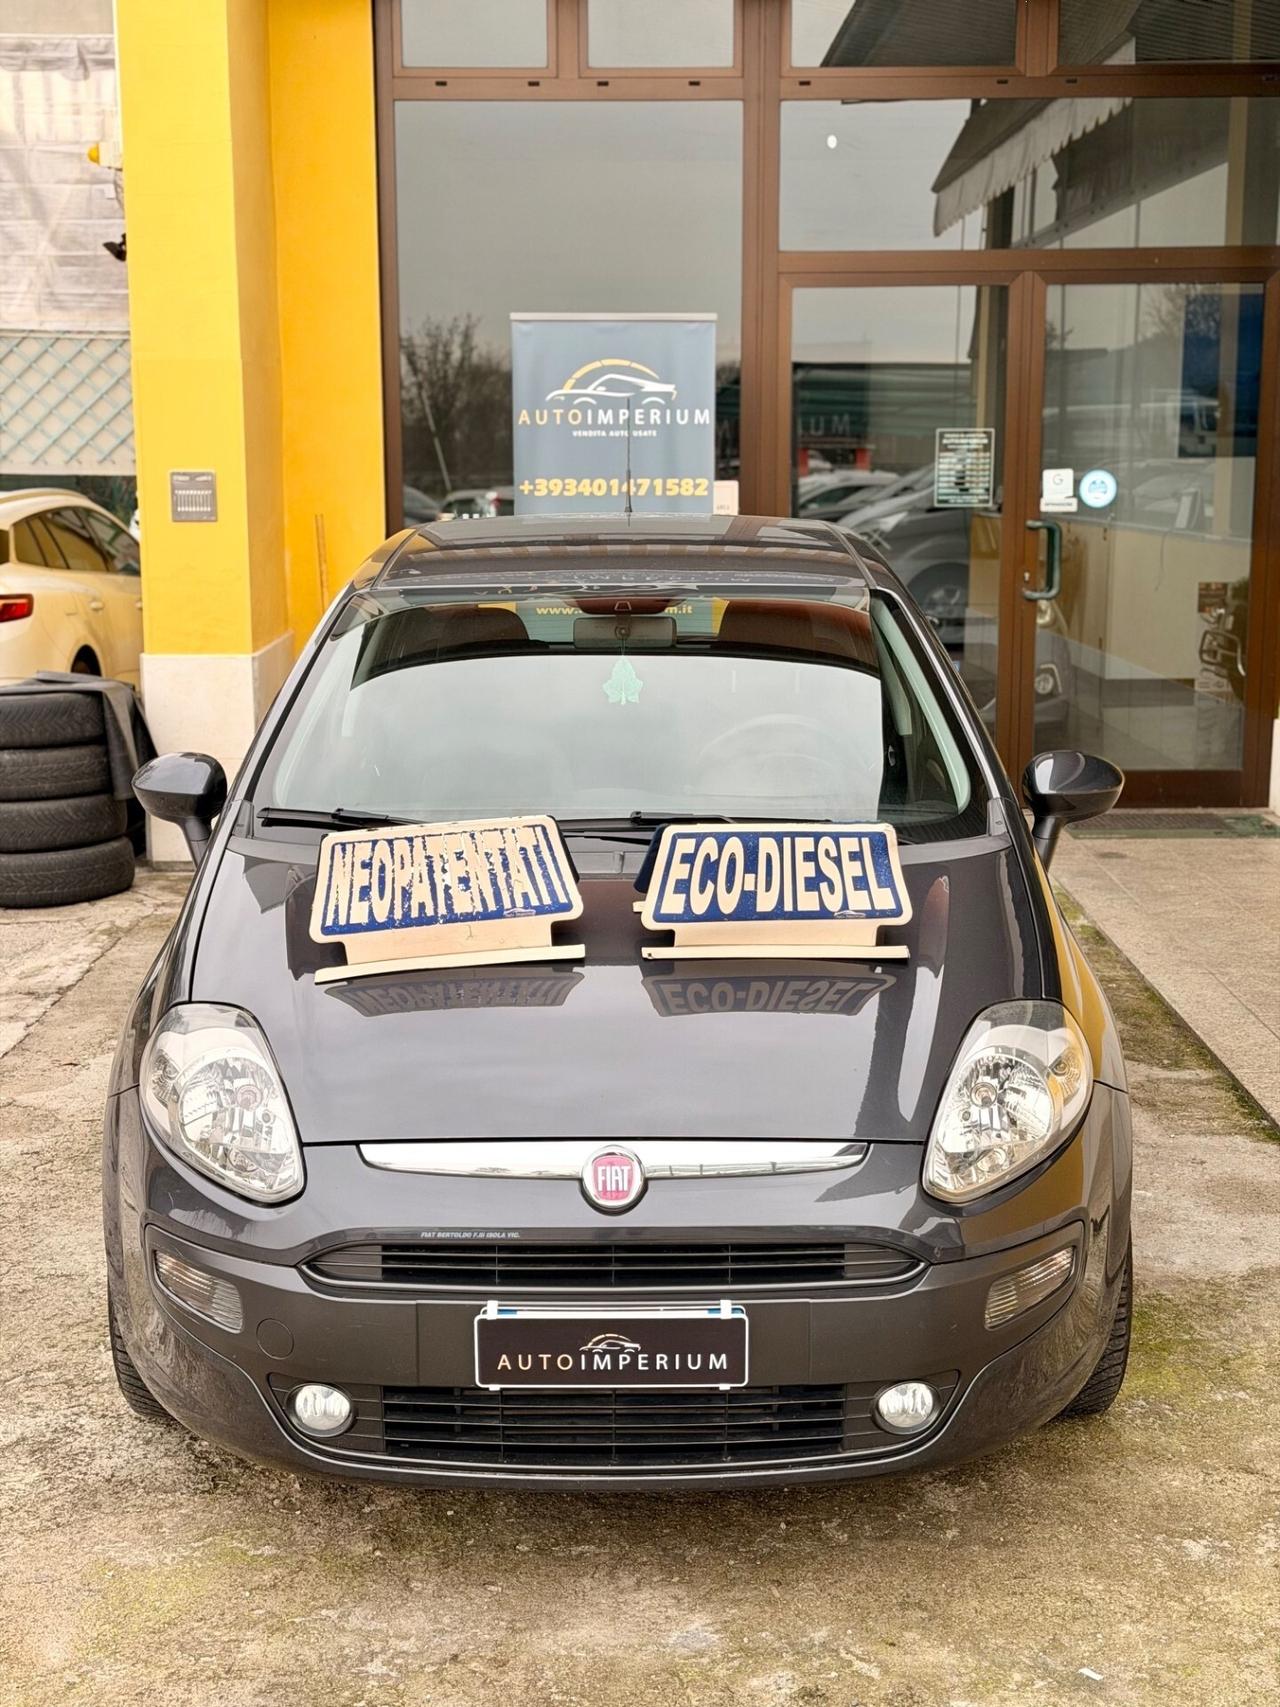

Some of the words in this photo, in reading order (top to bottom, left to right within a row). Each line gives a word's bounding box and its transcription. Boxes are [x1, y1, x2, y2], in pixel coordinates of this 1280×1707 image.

[518, 408, 711, 425] AUTOIMPERIUM
[572, 429, 607, 437] VENDITA
[632, 429, 657, 437] USATE
[518, 478, 709, 497] +393401471582
[325, 826, 569, 927] NEOPATENTATI
[659, 836, 897, 915] ECO-DIESEL
[598, 1165, 631, 1191] FIAT
[497, 1353, 728, 1370] AUTOIMPERIUM
